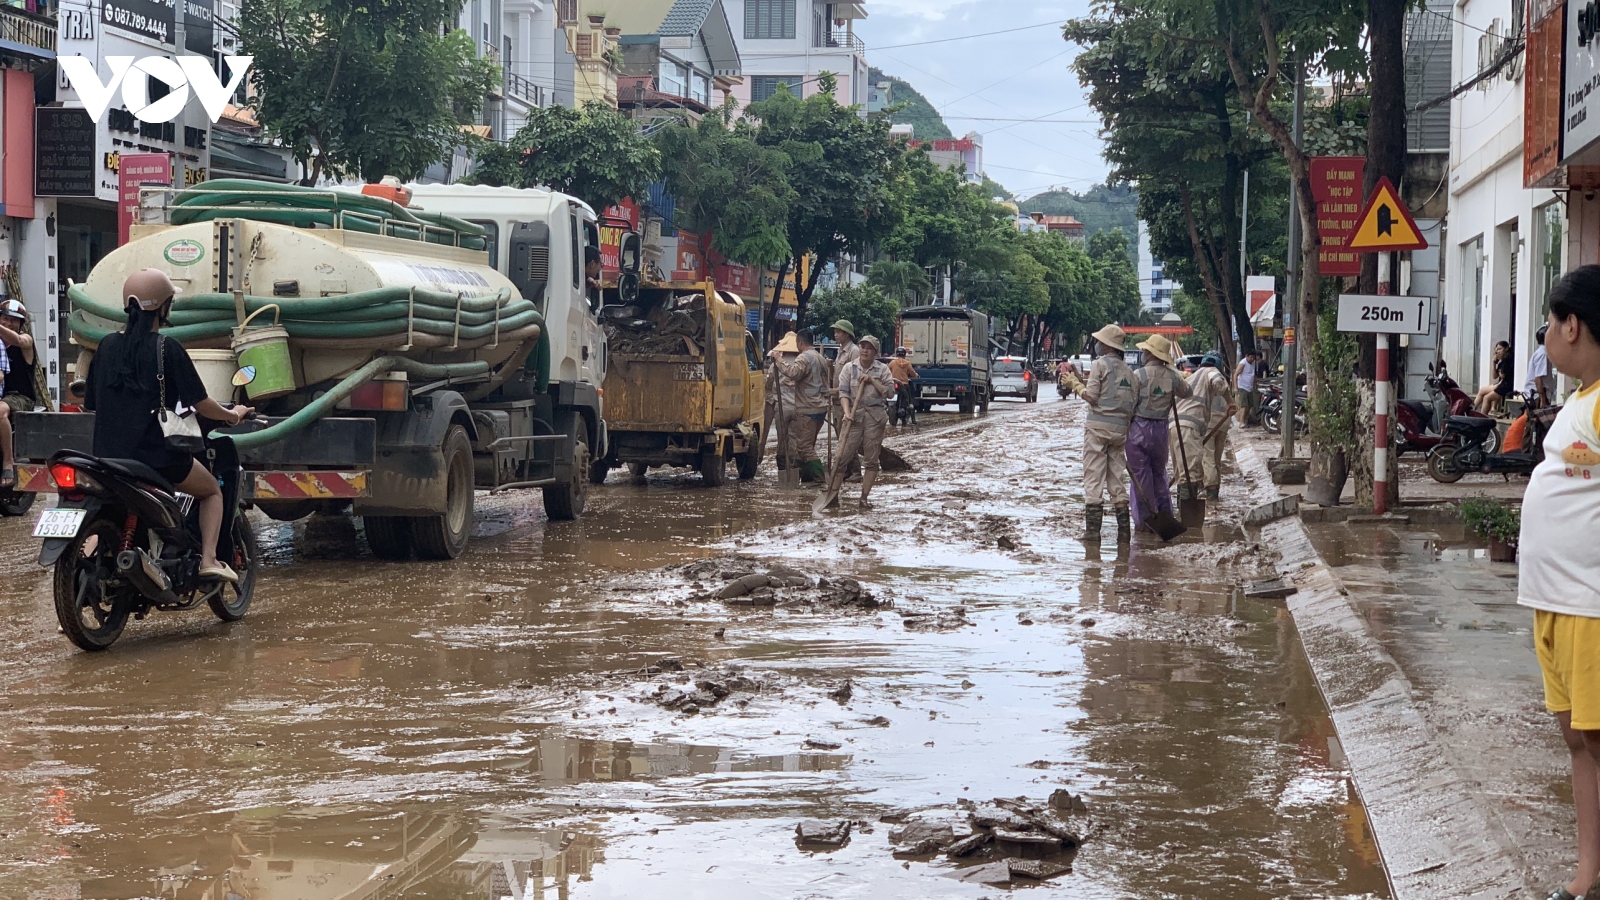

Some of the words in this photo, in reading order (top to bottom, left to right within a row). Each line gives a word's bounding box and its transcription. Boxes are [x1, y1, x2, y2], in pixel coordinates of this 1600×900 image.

[165, 0, 187, 13] APE
[188, 2, 212, 22] WATCH
[114, 7, 168, 37] 087.789.4444
[64, 130, 91, 141] HUY
[1338, 170, 1355, 182] MẠNH
[1343, 186, 1353, 198] TẬP
[1322, 202, 1330, 213] VÀ
[1331, 202, 1343, 213] LÀM
[1344, 203, 1358, 213] THEO
[1322, 236, 1341, 246] PHONG
[1328, 250, 1337, 262] CHÍ
[1361, 306, 1404, 321] 250m
[45, 511, 78, 523] 26-F1
[38, 523, 77, 536] 159.03
